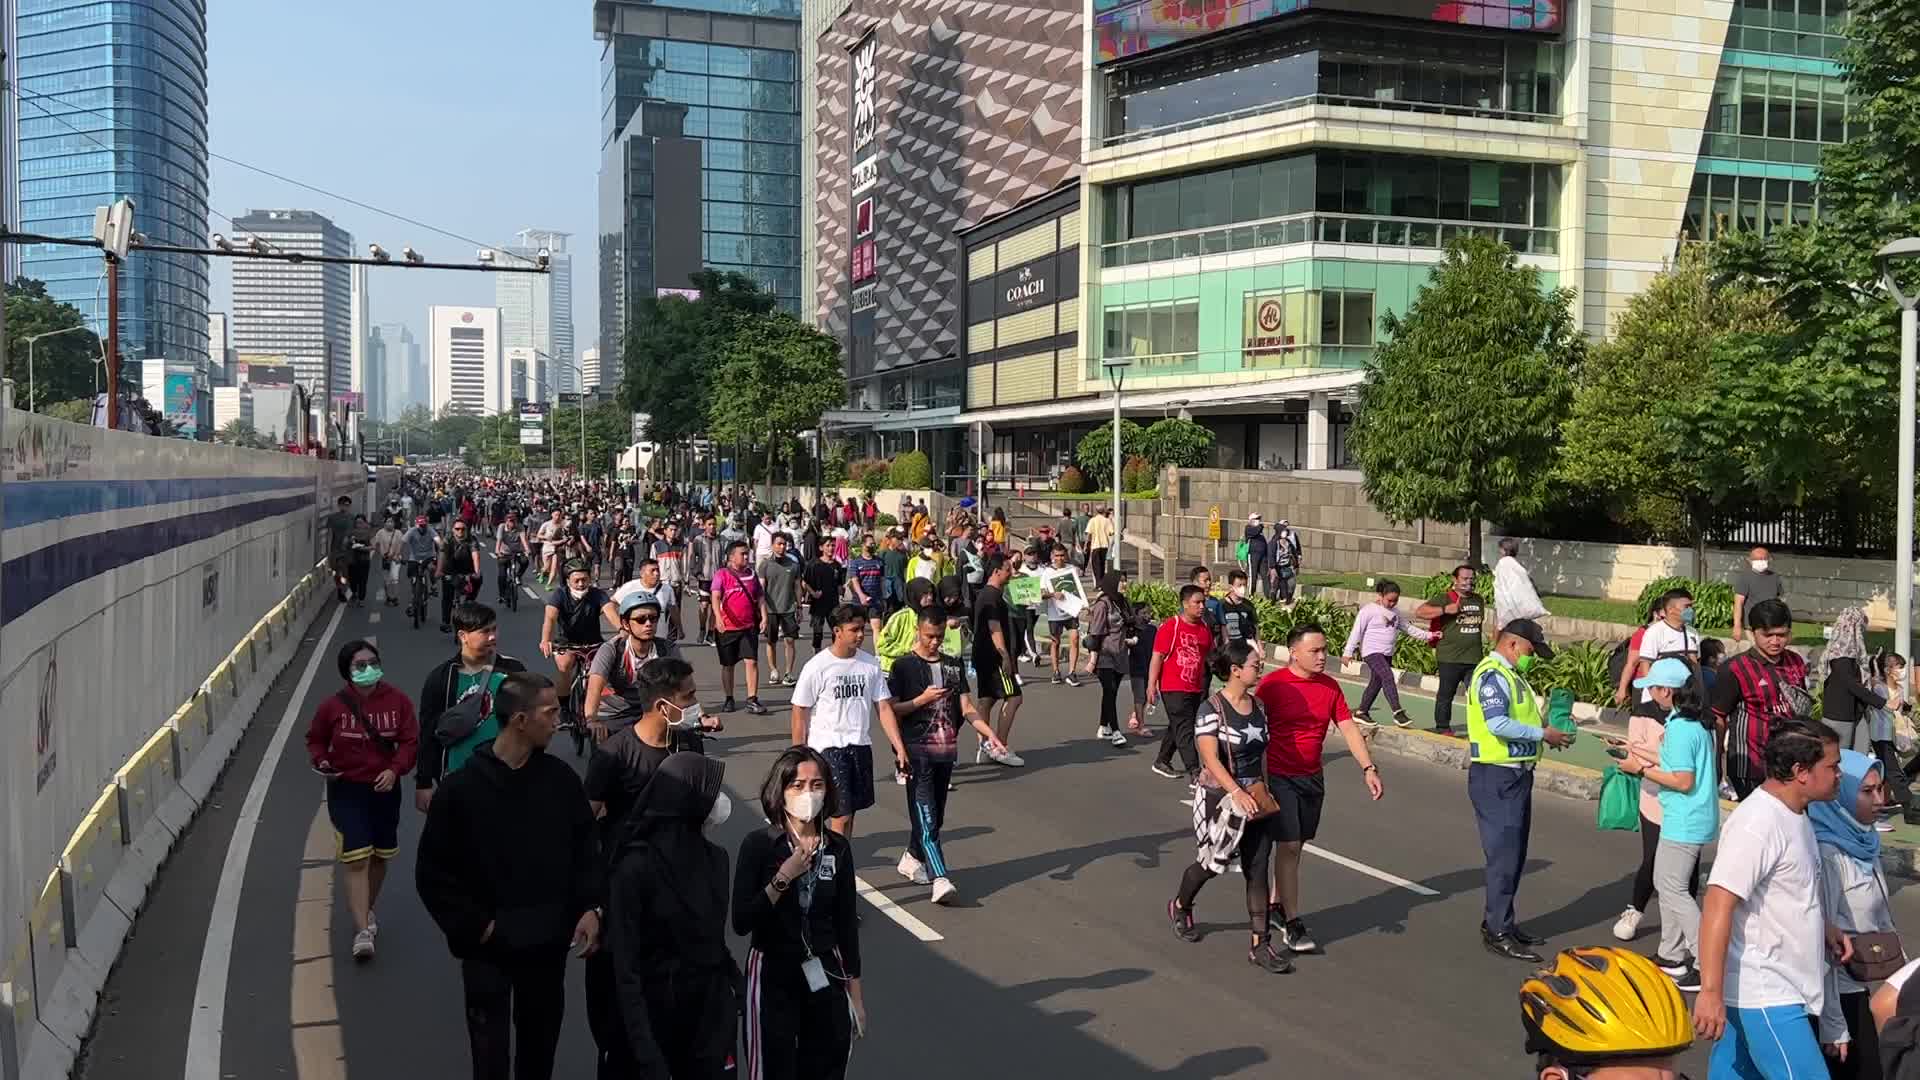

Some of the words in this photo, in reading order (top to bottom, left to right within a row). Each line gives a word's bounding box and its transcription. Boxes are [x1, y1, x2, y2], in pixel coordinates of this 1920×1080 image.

[852, 161, 877, 190] ZARA
[1007, 279, 1044, 302] COACH
[834, 684, 865, 700] GLORY
